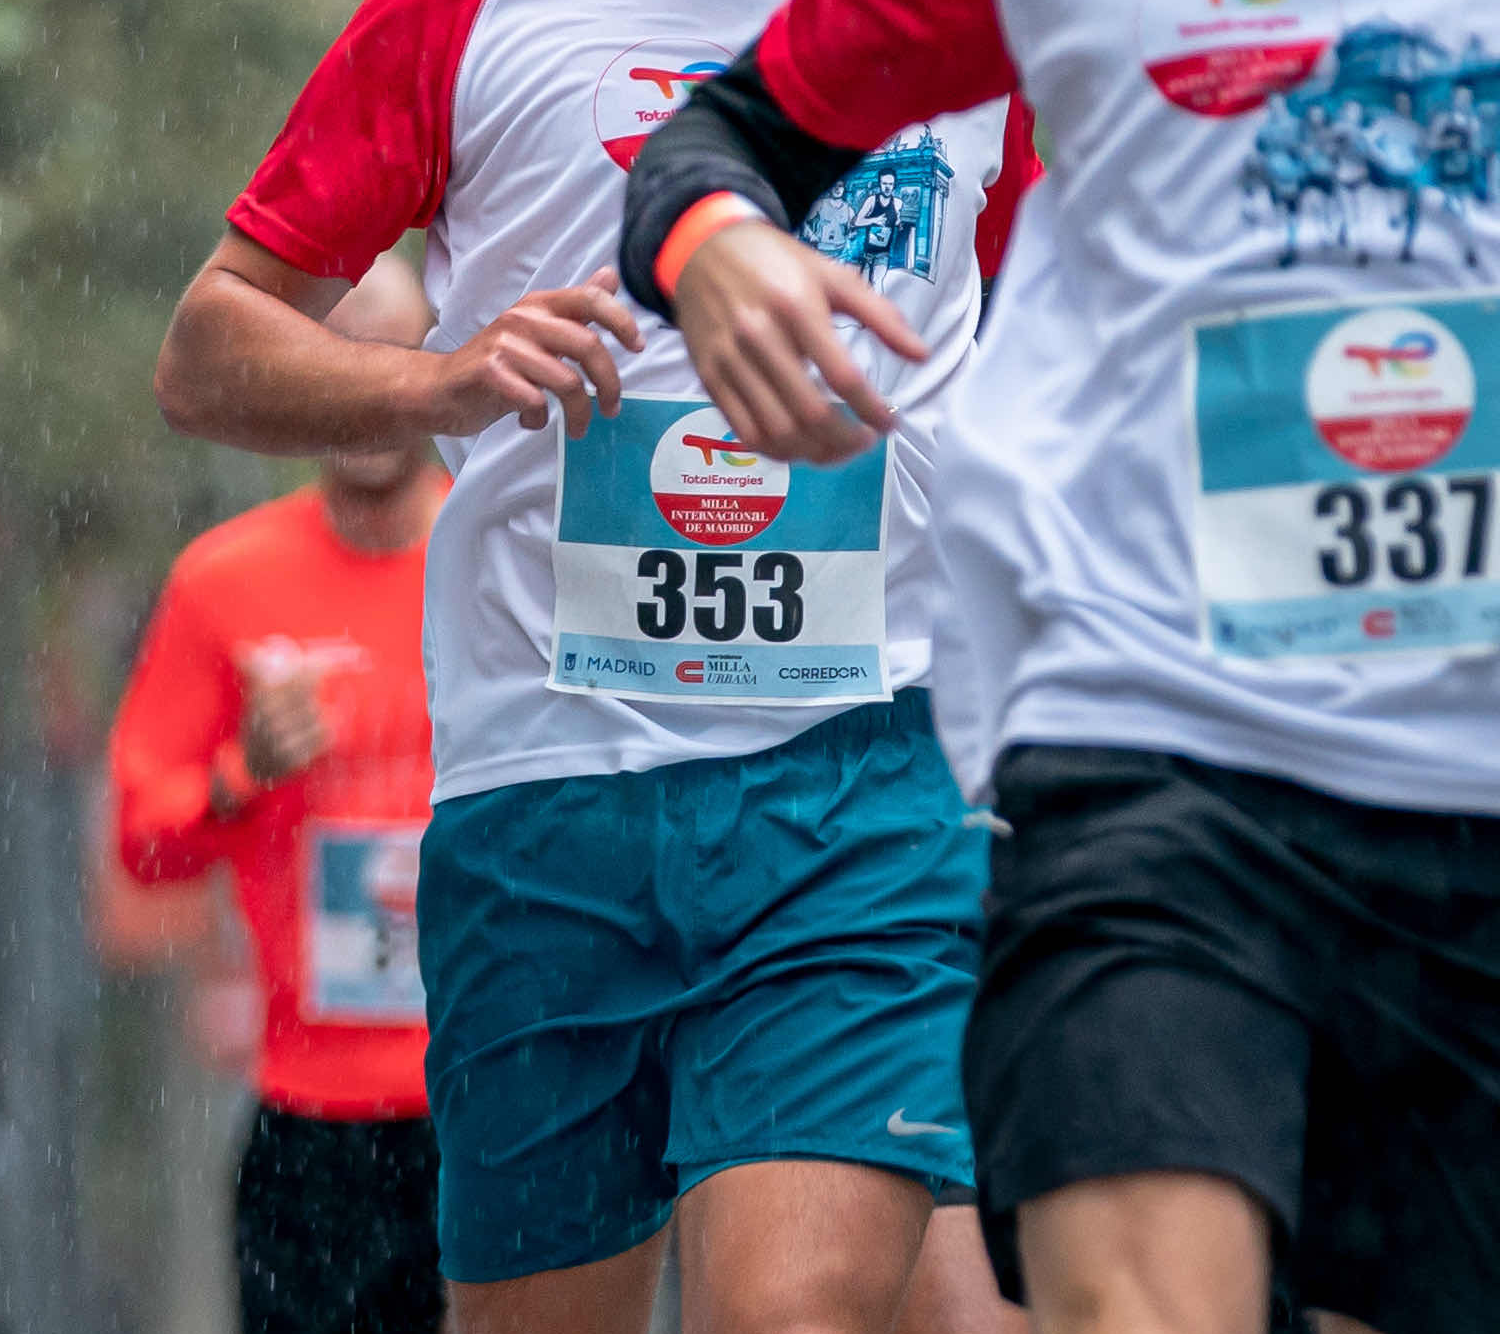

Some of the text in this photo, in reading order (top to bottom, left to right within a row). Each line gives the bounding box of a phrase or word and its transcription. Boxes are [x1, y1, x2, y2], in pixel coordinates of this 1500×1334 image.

[681, 474, 764, 488] TotalEnergies
[701, 499, 739, 509] MILLA
[685, 523, 754, 534] DE MADRID
[1316, 476, 1494, 586] 337
[636, 549, 804, 643] 353
[587, 656, 656, 677] MADRID
[708, 661, 751, 672] MILLA
